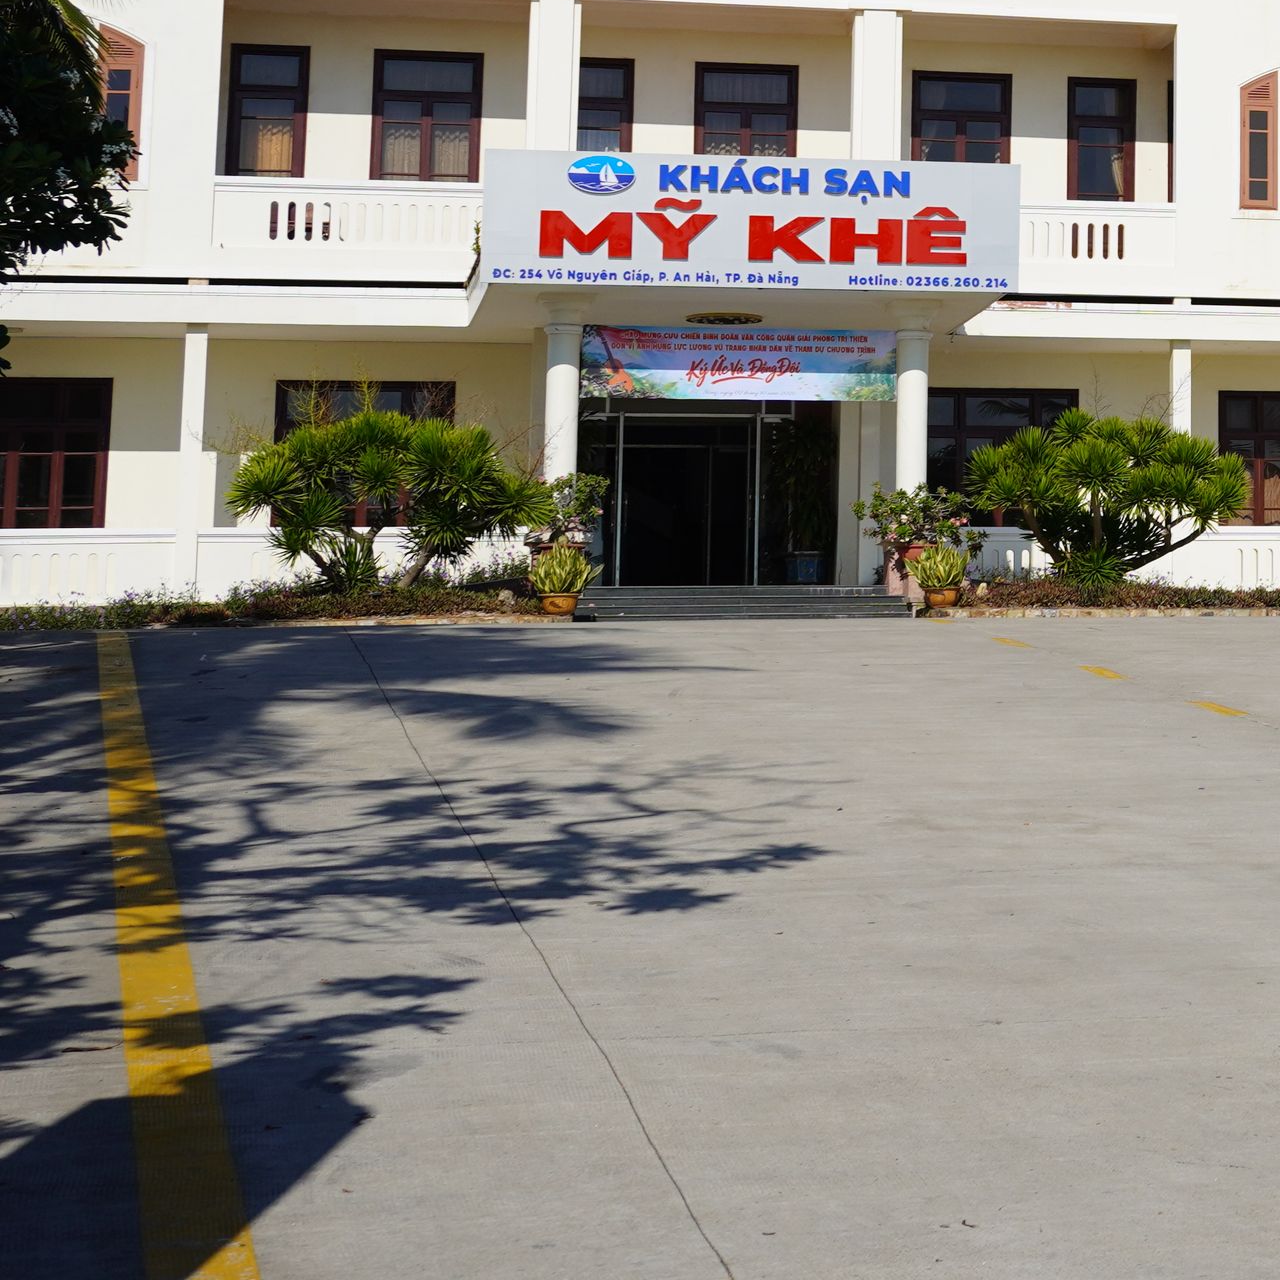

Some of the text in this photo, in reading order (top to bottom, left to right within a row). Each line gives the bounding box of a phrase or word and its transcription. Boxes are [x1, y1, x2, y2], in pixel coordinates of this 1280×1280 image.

[658, 158, 911, 205] KHÁCH SẠN
[539, 196, 968, 266] MỸ KHÊ
[492, 267, 515, 279] ĐC:
[519, 268, 543, 280] 254
[547, 268, 563, 280] Võ
[567, 269, 618, 283] Nguyên
[623, 269, 654, 283] Giáp,
[658, 271, 669, 282] P.
[673, 271, 691, 282] An
[725, 272, 743, 283] TP.
[747, 272, 764, 284] Đà
[768, 270, 800, 287] Nẵng
[848, 274, 1009, 289] Hotline: 02366.260.214
[686, 357, 708, 387] Ký
[730, 358, 745, 376] Và
